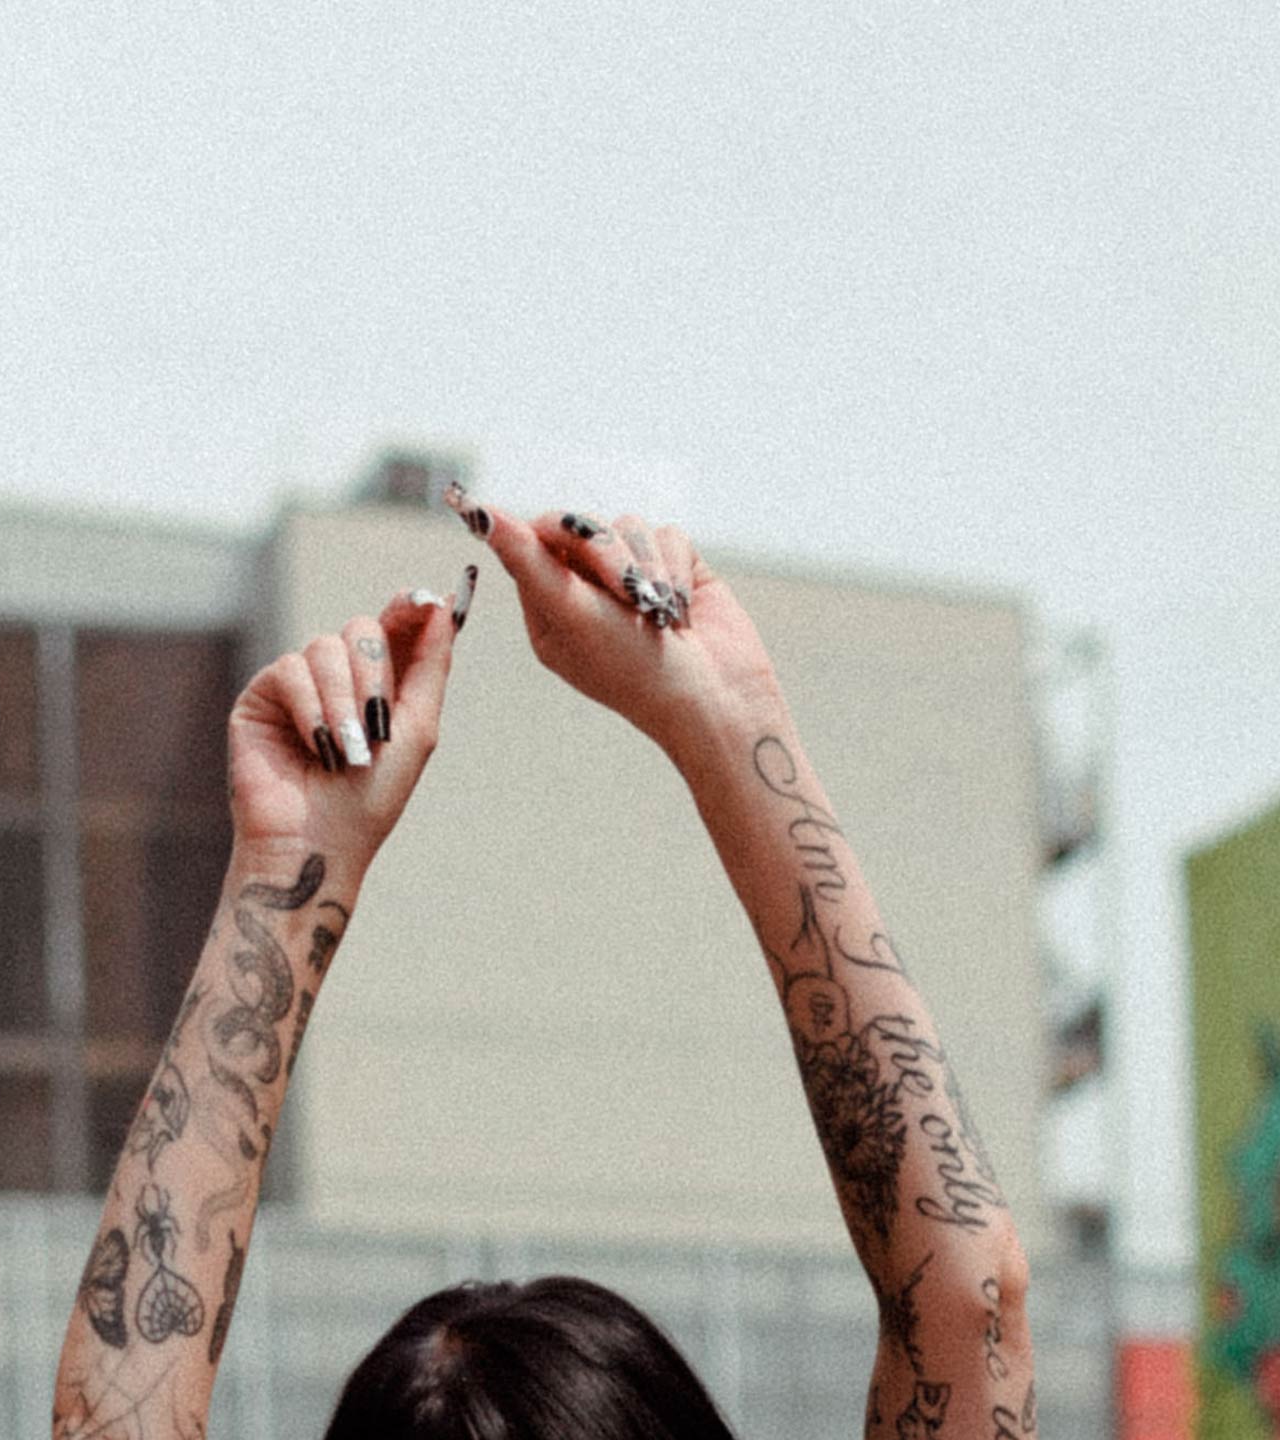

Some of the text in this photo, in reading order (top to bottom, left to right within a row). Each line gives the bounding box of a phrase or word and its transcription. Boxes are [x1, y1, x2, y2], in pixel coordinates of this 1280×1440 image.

[753, 735, 846, 903] Am
[873, 1013, 948, 1099] the
[915, 1113, 1010, 1236] only
